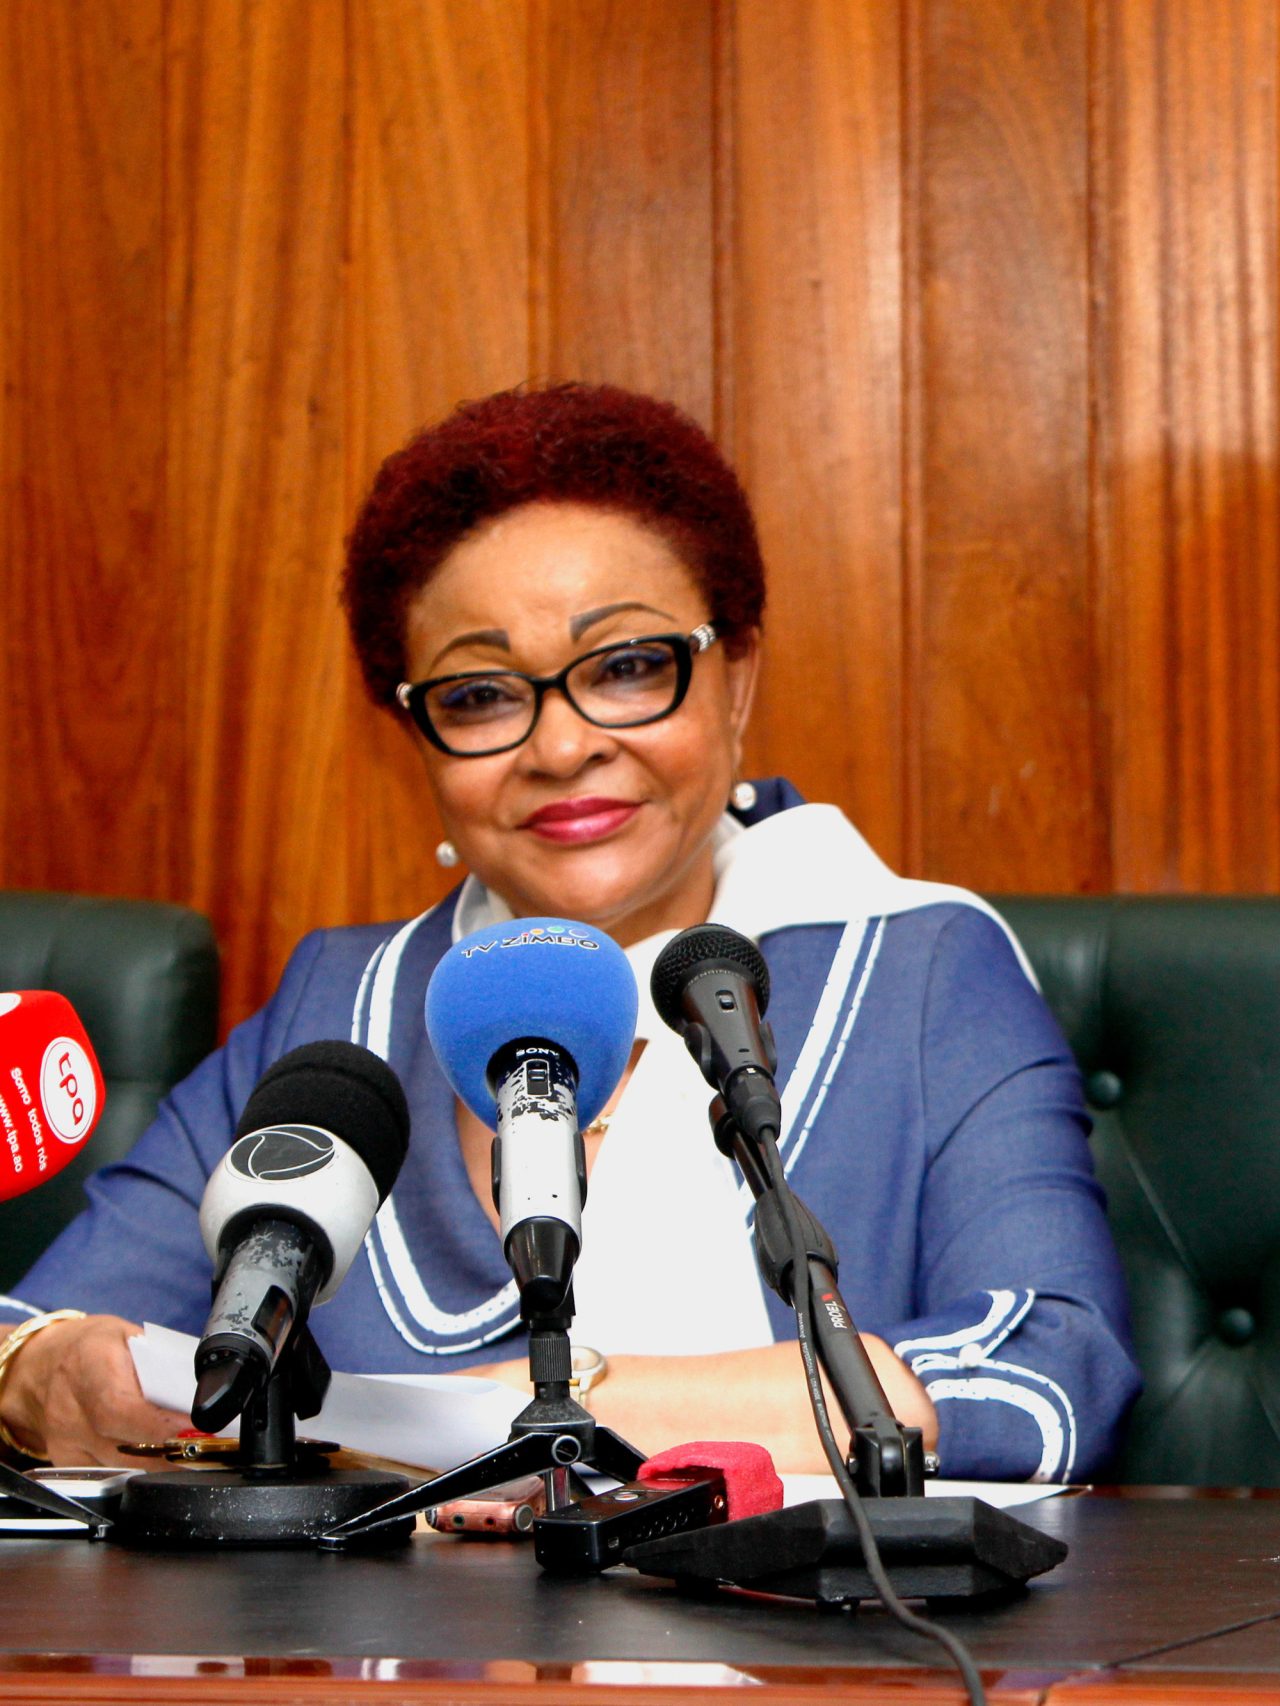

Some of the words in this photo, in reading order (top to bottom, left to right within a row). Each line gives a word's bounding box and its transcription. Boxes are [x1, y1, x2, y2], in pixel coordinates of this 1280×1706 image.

[461, 940, 497, 958] TV
[515, 1047, 560, 1057] SONY
[28, 1107, 43, 1146] todos
[825, 1300, 847, 1329] PROEL
